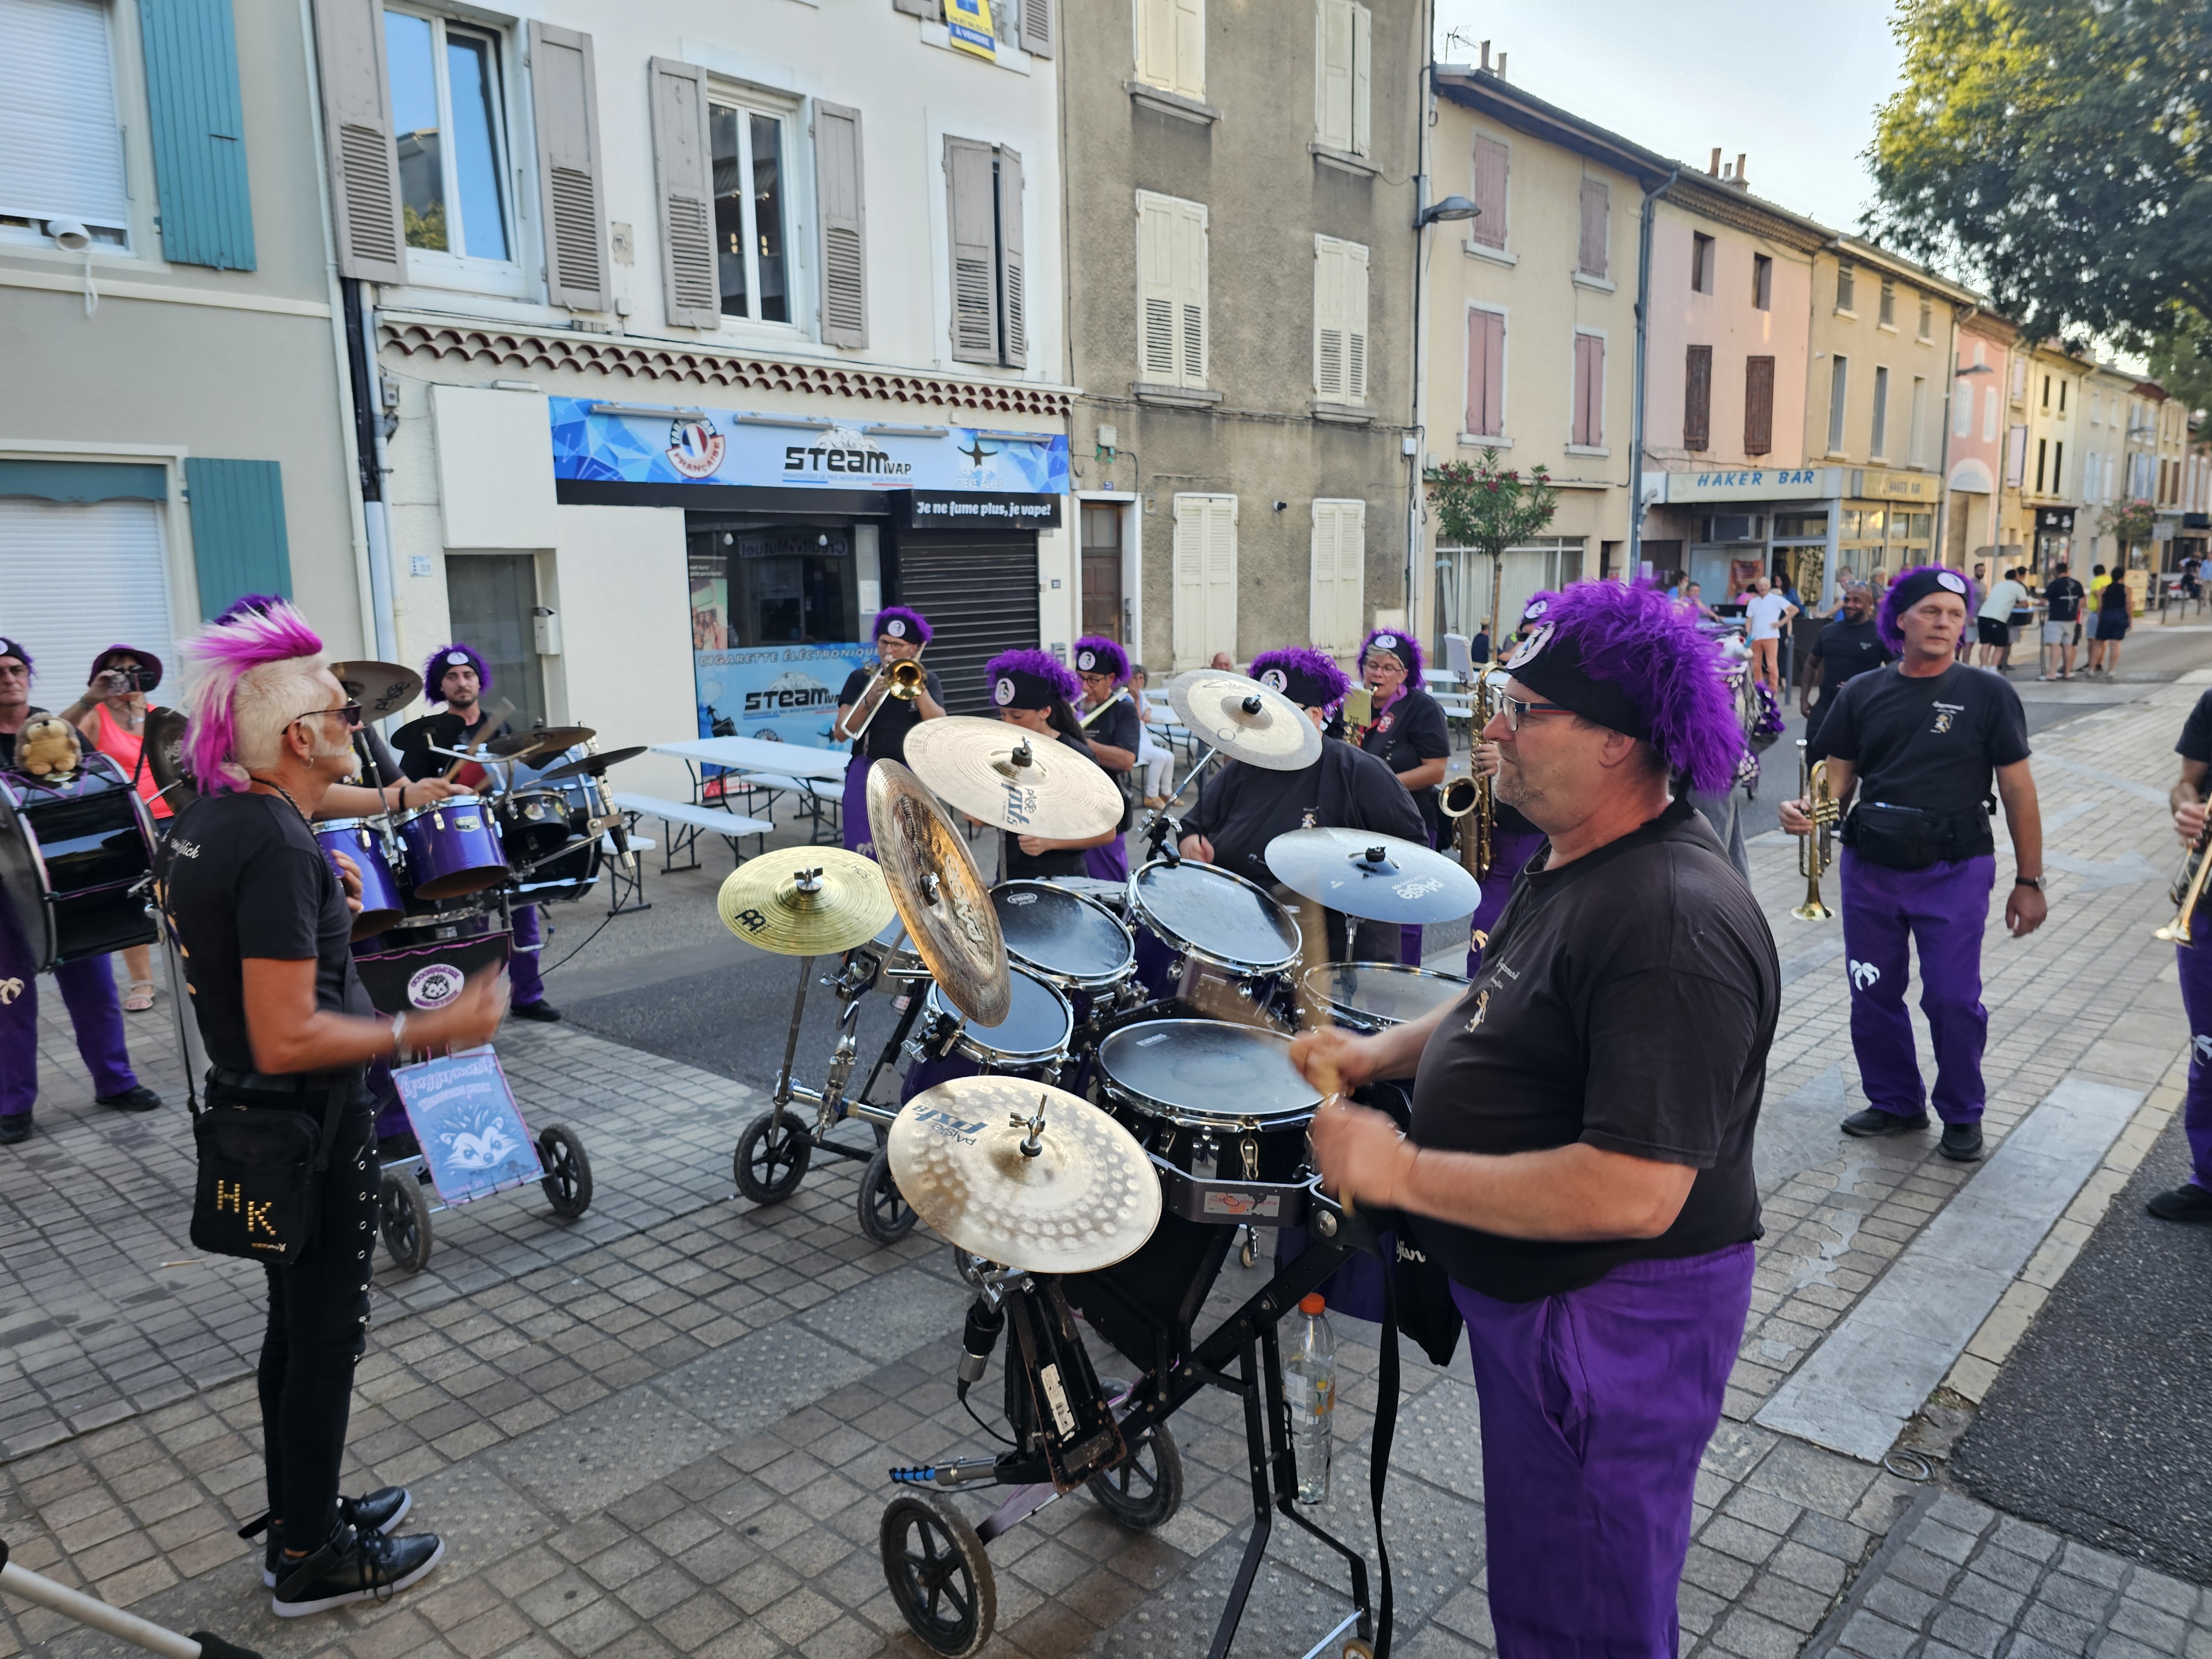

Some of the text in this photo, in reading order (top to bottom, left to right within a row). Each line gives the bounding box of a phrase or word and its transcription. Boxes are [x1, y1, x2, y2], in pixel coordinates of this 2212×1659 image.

[1697, 471, 1815, 487] HAKER BAR
[917, 501, 1052, 518] Je ne fume plus, je vape!
[699, 651, 779, 667] CIGARETTE
[851, 864, 869, 880] HCS
[1135, 1032, 1167, 1046] EVANS
